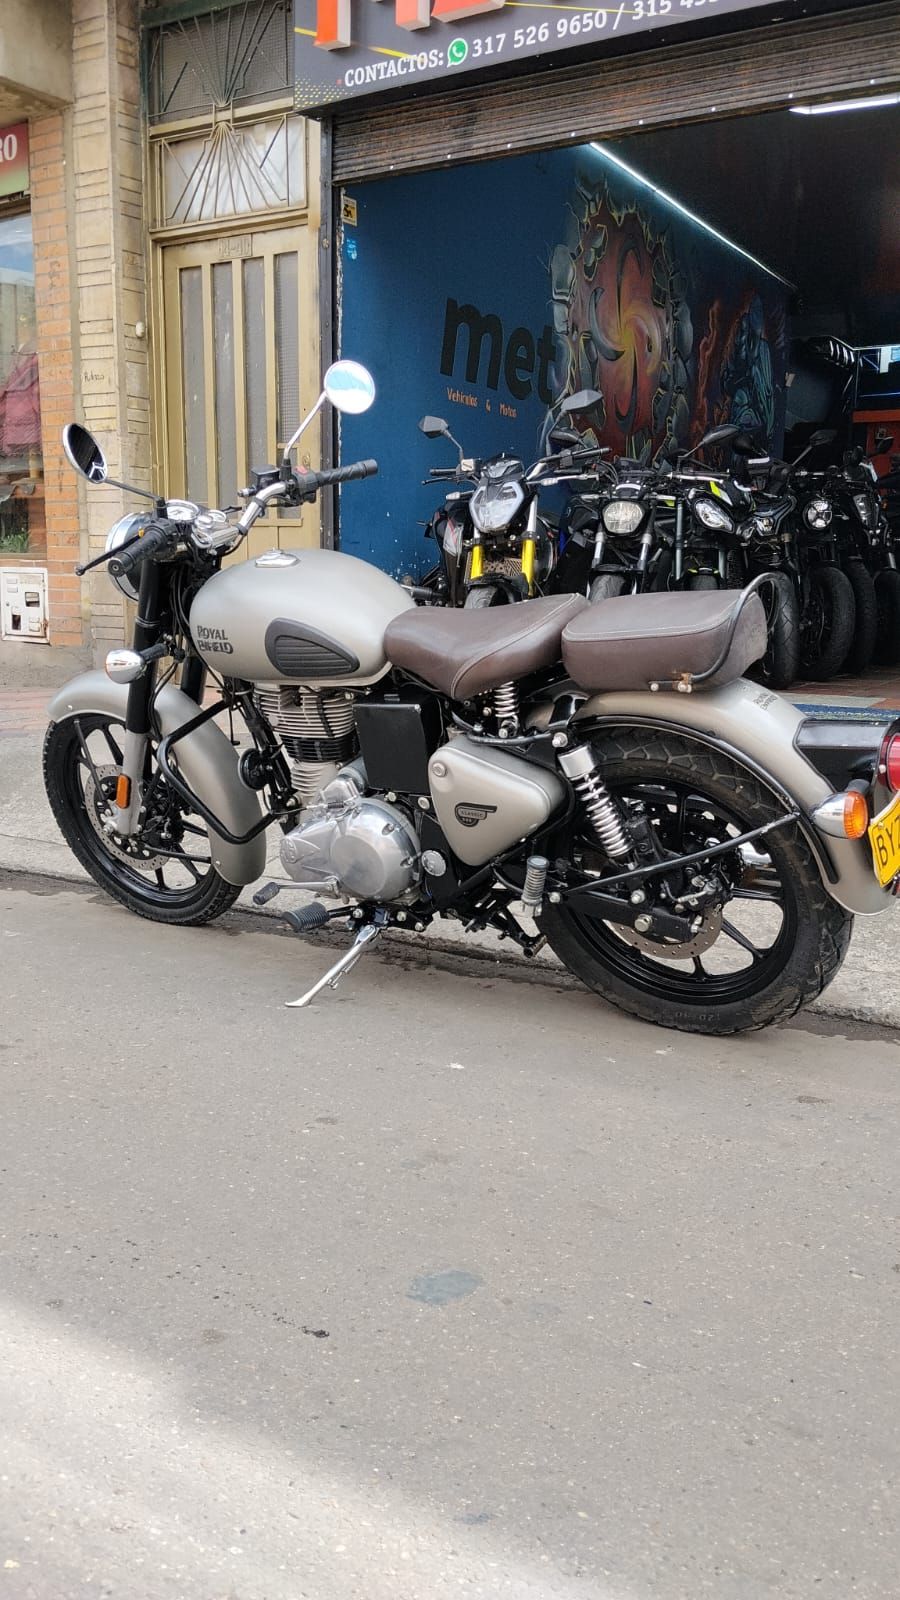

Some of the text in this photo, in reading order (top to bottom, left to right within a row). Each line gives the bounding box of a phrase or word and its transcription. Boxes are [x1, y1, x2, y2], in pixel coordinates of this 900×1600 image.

[344, 49, 444, 87] CONTACTOS:
[472, 34, 506, 58] 317
[513, 23, 549, 48] 526
[556, 10, 607, 38] 9650
[612, 3, 624, 30] /
[632, 0, 672, 20] 315
[0, 134, 17, 163] O
[197, 625, 228, 640] ROYAL
[197, 640, 234, 654] ENFIELD
